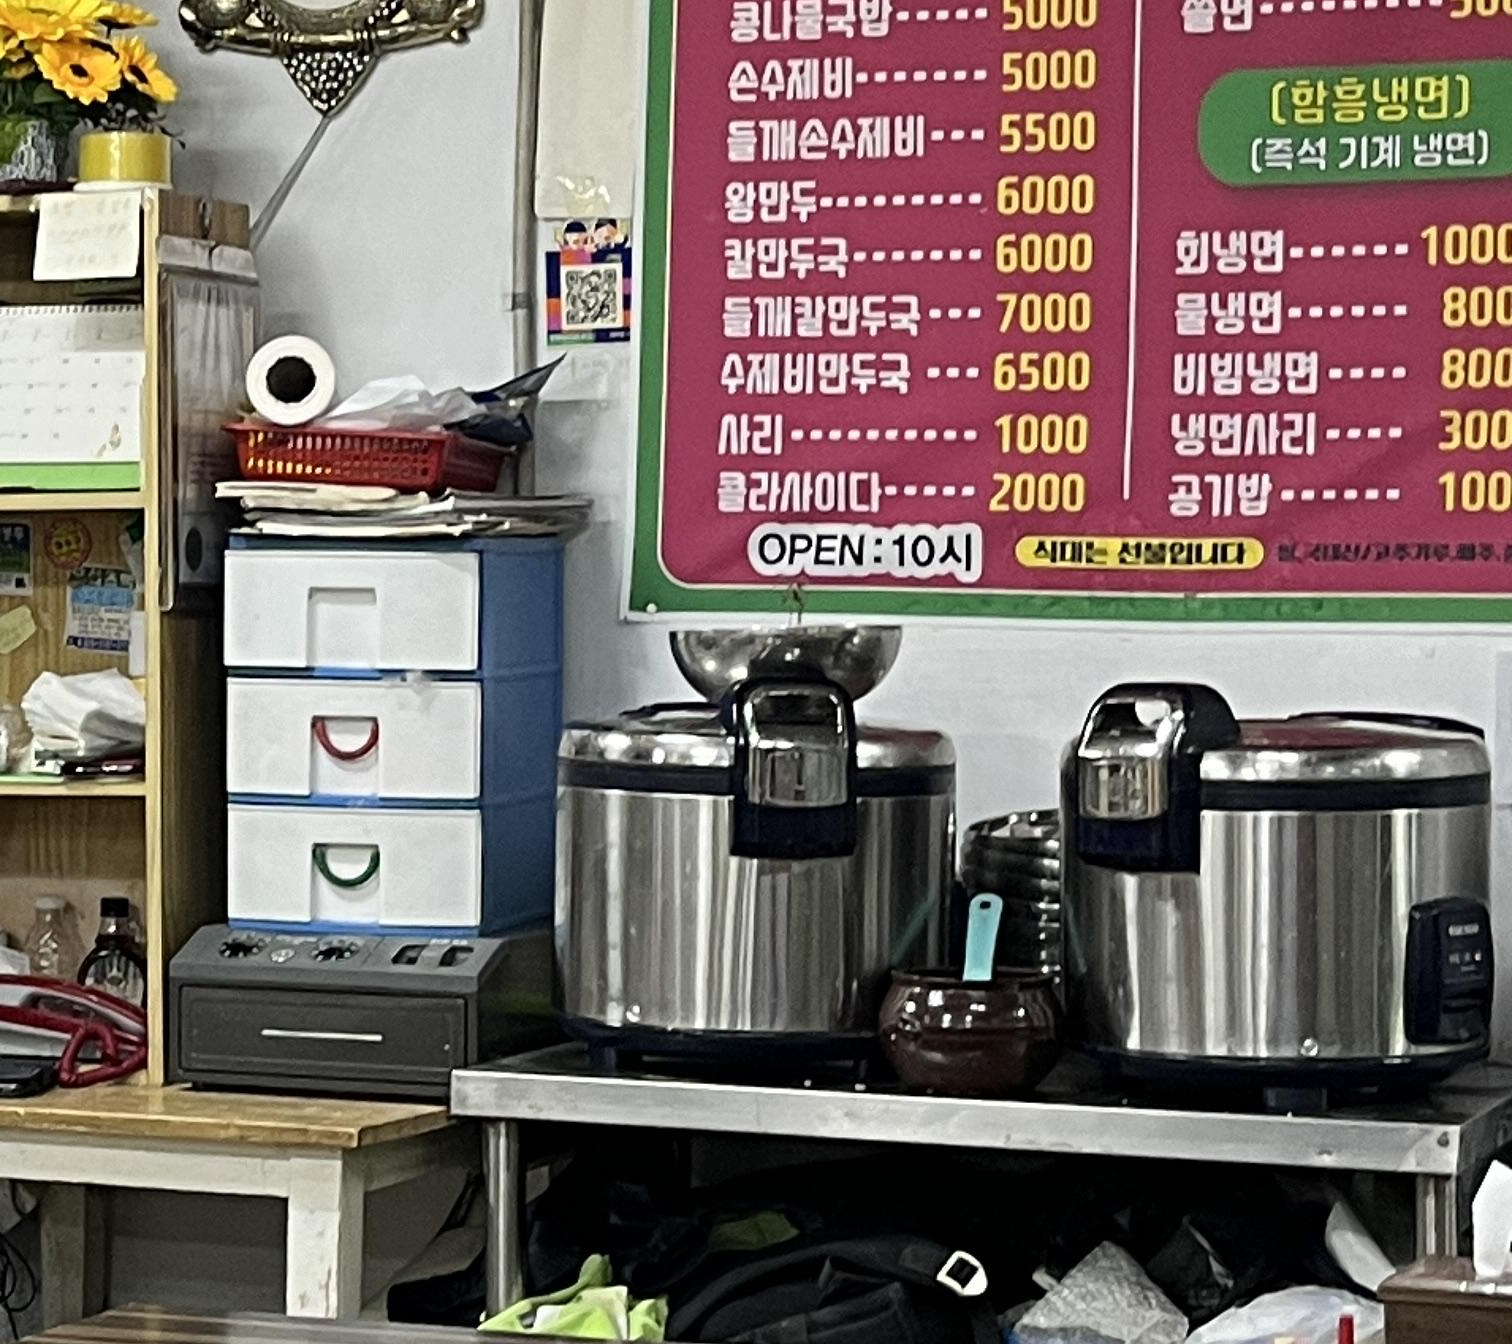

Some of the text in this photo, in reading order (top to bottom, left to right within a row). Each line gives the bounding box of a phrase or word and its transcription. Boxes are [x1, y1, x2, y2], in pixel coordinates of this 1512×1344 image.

[728, 49, 1096, 102] 손수제비 5000
[1270, 74, 1470, 125] (함흥냉면)
[727, 111, 1095, 162] 들깨손수제비 5500
[1250, 129, 1489, 173] (즉석 기계 냉면)
[725, 174, 1095, 224] 왕만두 6000
[724, 233, 1094, 280] 칼만두국 6000
[1175, 230, 1284, 274] 회냉면
[723, 292, 1091, 338] 들깨칼만두국 7000
[1175, 290, 1282, 336] 물냉면
[720, 351, 1091, 395] 수제비만두국 6500
[1173, 351, 1318, 396] 비빔냉면
[717, 413, 1088, 456] 사리 1000
[1171, 411, 1316, 456] 냉면사리
[717, 471, 1086, 513] 콜라사이다 2000
[1168, 473, 1273, 518] 공기밥
[1034, 540, 1245, 565] 식대는 선불입니다
